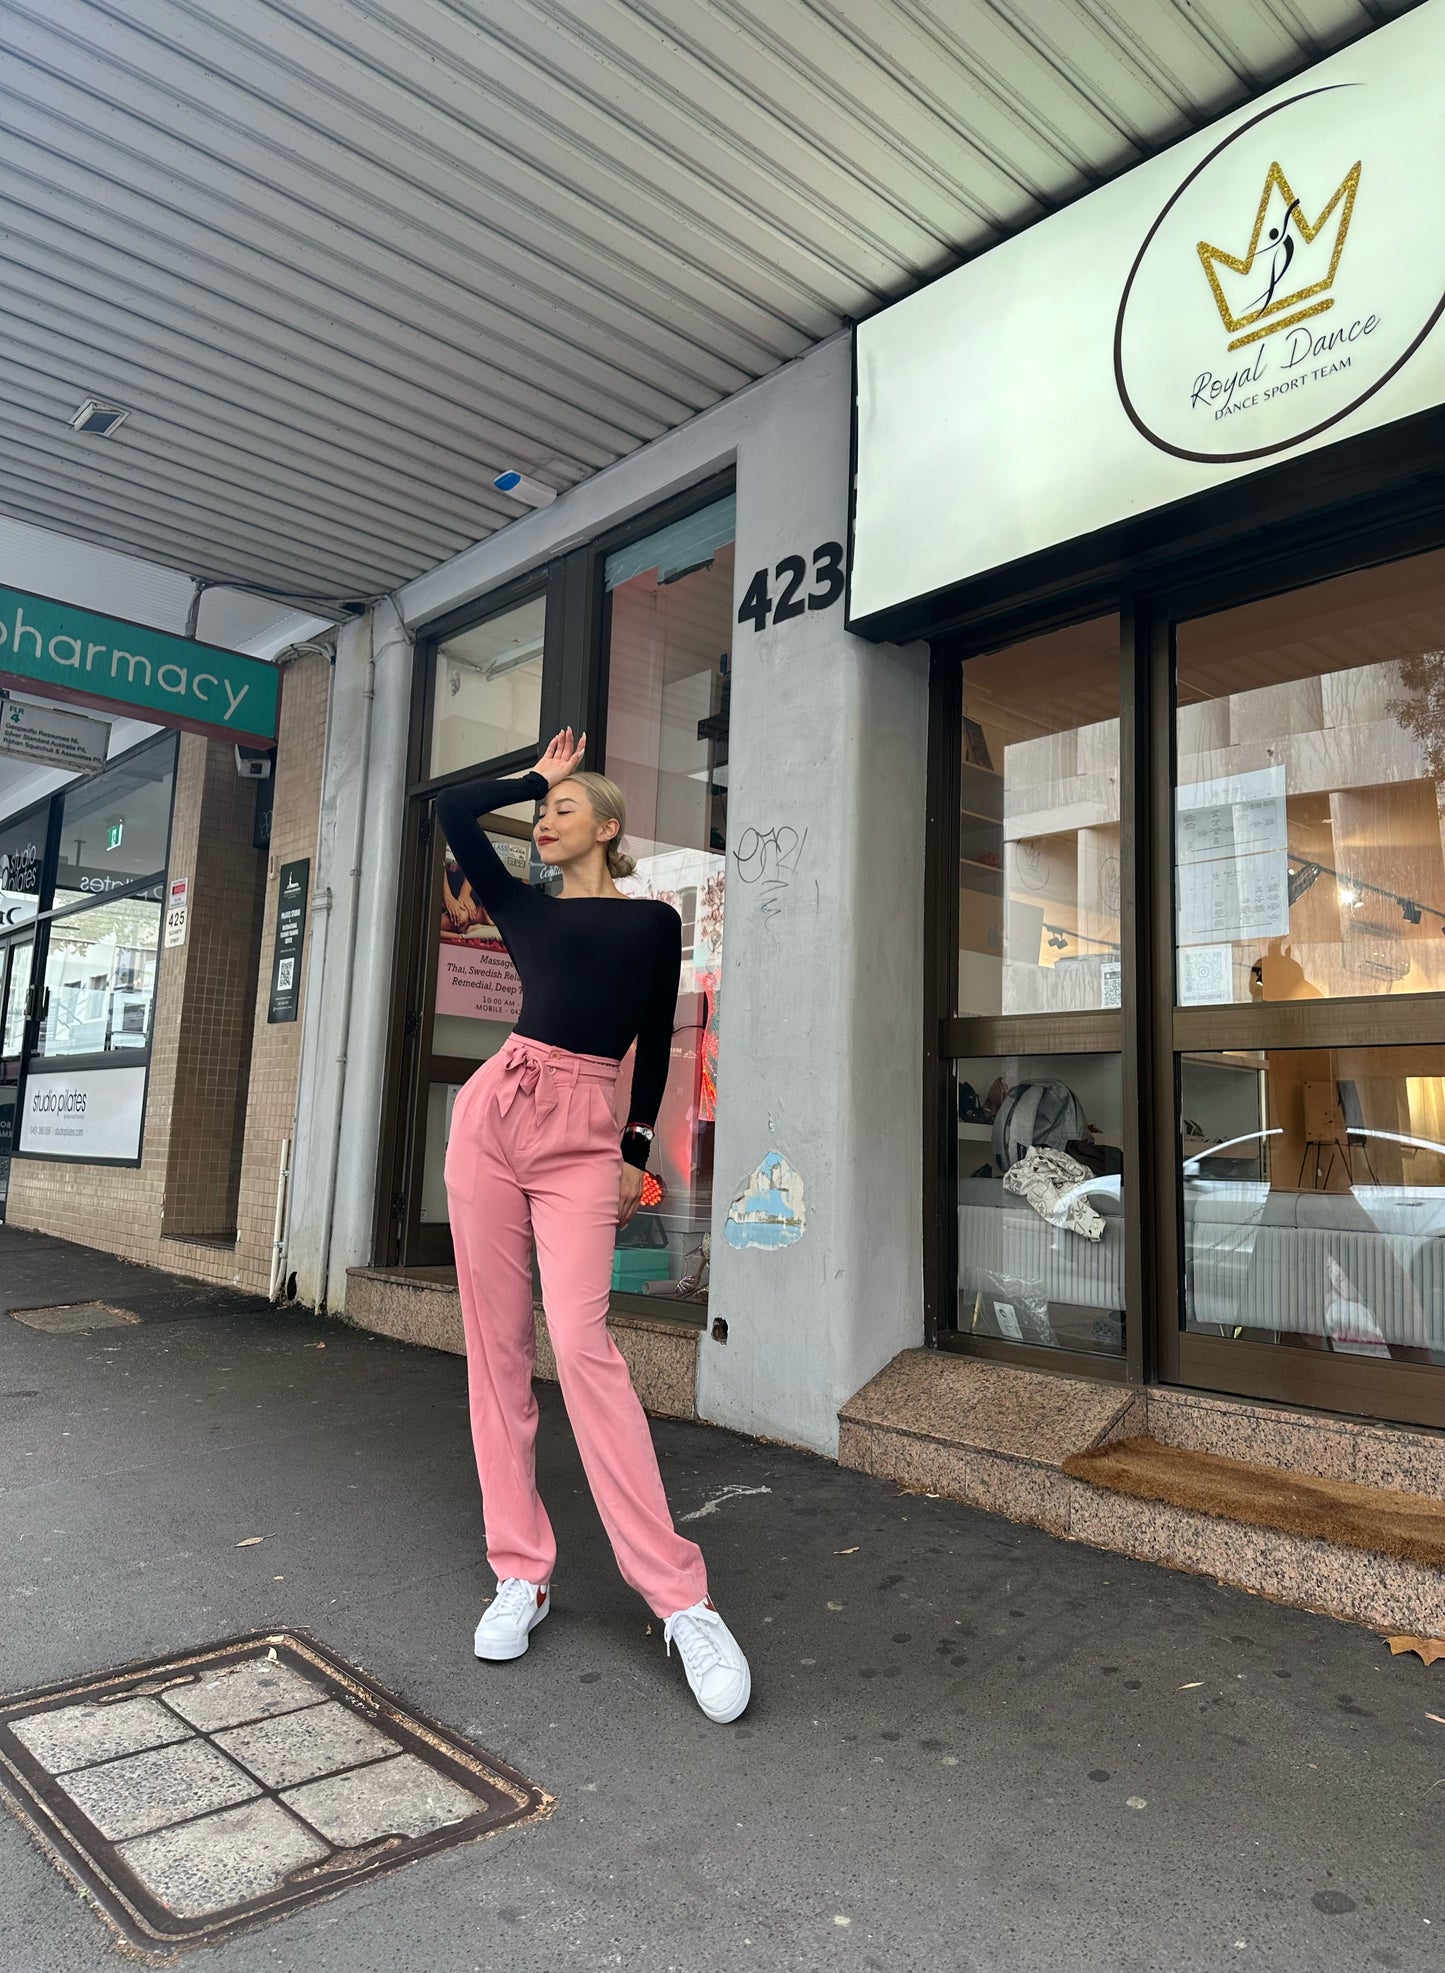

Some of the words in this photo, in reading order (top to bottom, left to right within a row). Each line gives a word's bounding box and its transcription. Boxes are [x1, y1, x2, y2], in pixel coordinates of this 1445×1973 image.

[1190, 343, 1267, 411] Royal
[1280, 314, 1381, 368] Dance
[1215, 395, 1259, 420] DANCE
[1263, 374, 1308, 402] SPORT
[1311, 357, 1352, 381] TEAM
[737, 541, 845, 632] 423
[9, 705, 25, 715] FLR
[10, 713, 21, 723] 4
[4, 729, 22, 738] Silver
[23, 733, 50, 745] Standard
[50, 740, 76, 751] Australia
[39, 729, 70, 743] Resources
[168, 911, 185, 927] 425
[447, 963, 467, 975] Thai,
[469, 966, 502, 979] Swedish
[452, 976, 494, 992] Remedial,
[495, 983, 517, 995] Deep
[476, 1004, 502, 1013] MOBILE
[33, 1089, 57, 1112] studio
[57, 1088, 87, 1117] pilates
